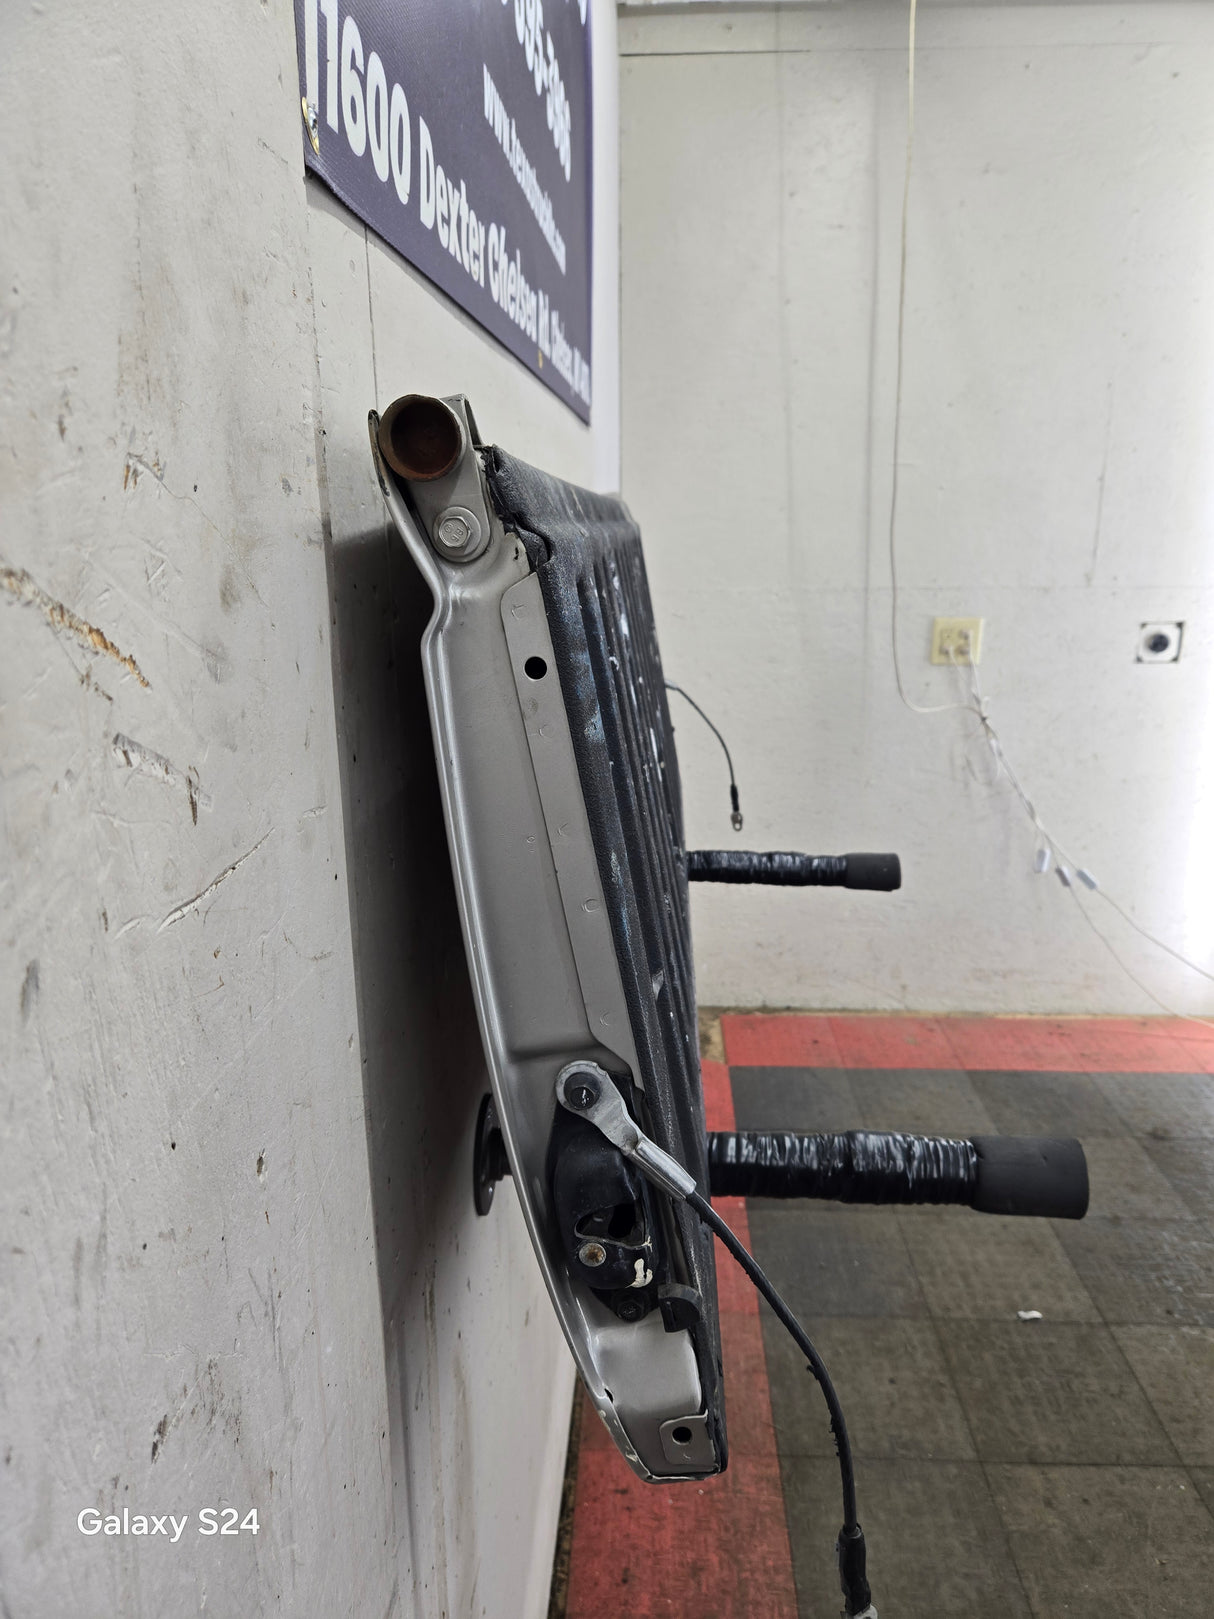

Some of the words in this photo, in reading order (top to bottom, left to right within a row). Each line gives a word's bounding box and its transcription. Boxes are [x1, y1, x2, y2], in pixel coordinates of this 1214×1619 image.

[305, 0, 411, 205] 11600
[420, 115, 485, 288] Dexter
[488, 223, 537, 344] Chelsea
